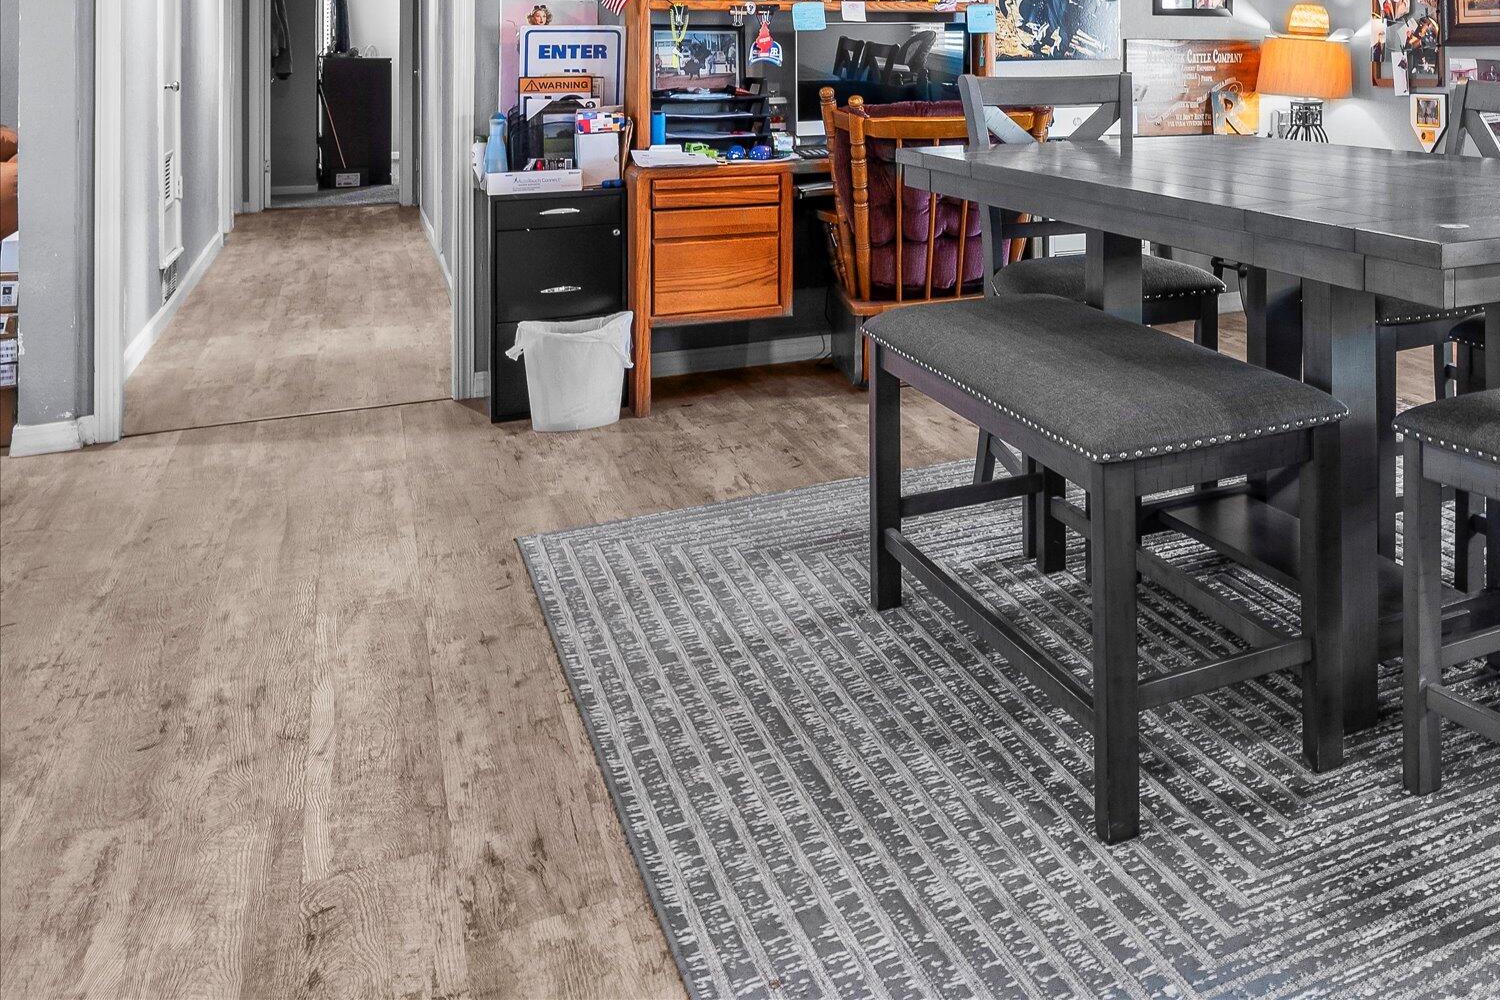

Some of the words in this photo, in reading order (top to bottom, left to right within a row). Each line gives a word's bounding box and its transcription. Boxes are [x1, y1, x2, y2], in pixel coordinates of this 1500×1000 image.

[538, 44, 608, 59] ENTER
[1187, 48, 1212, 64] CATTLE
[1213, 49, 1242, 64] COMPANY
[538, 81, 588, 89] WARNING
